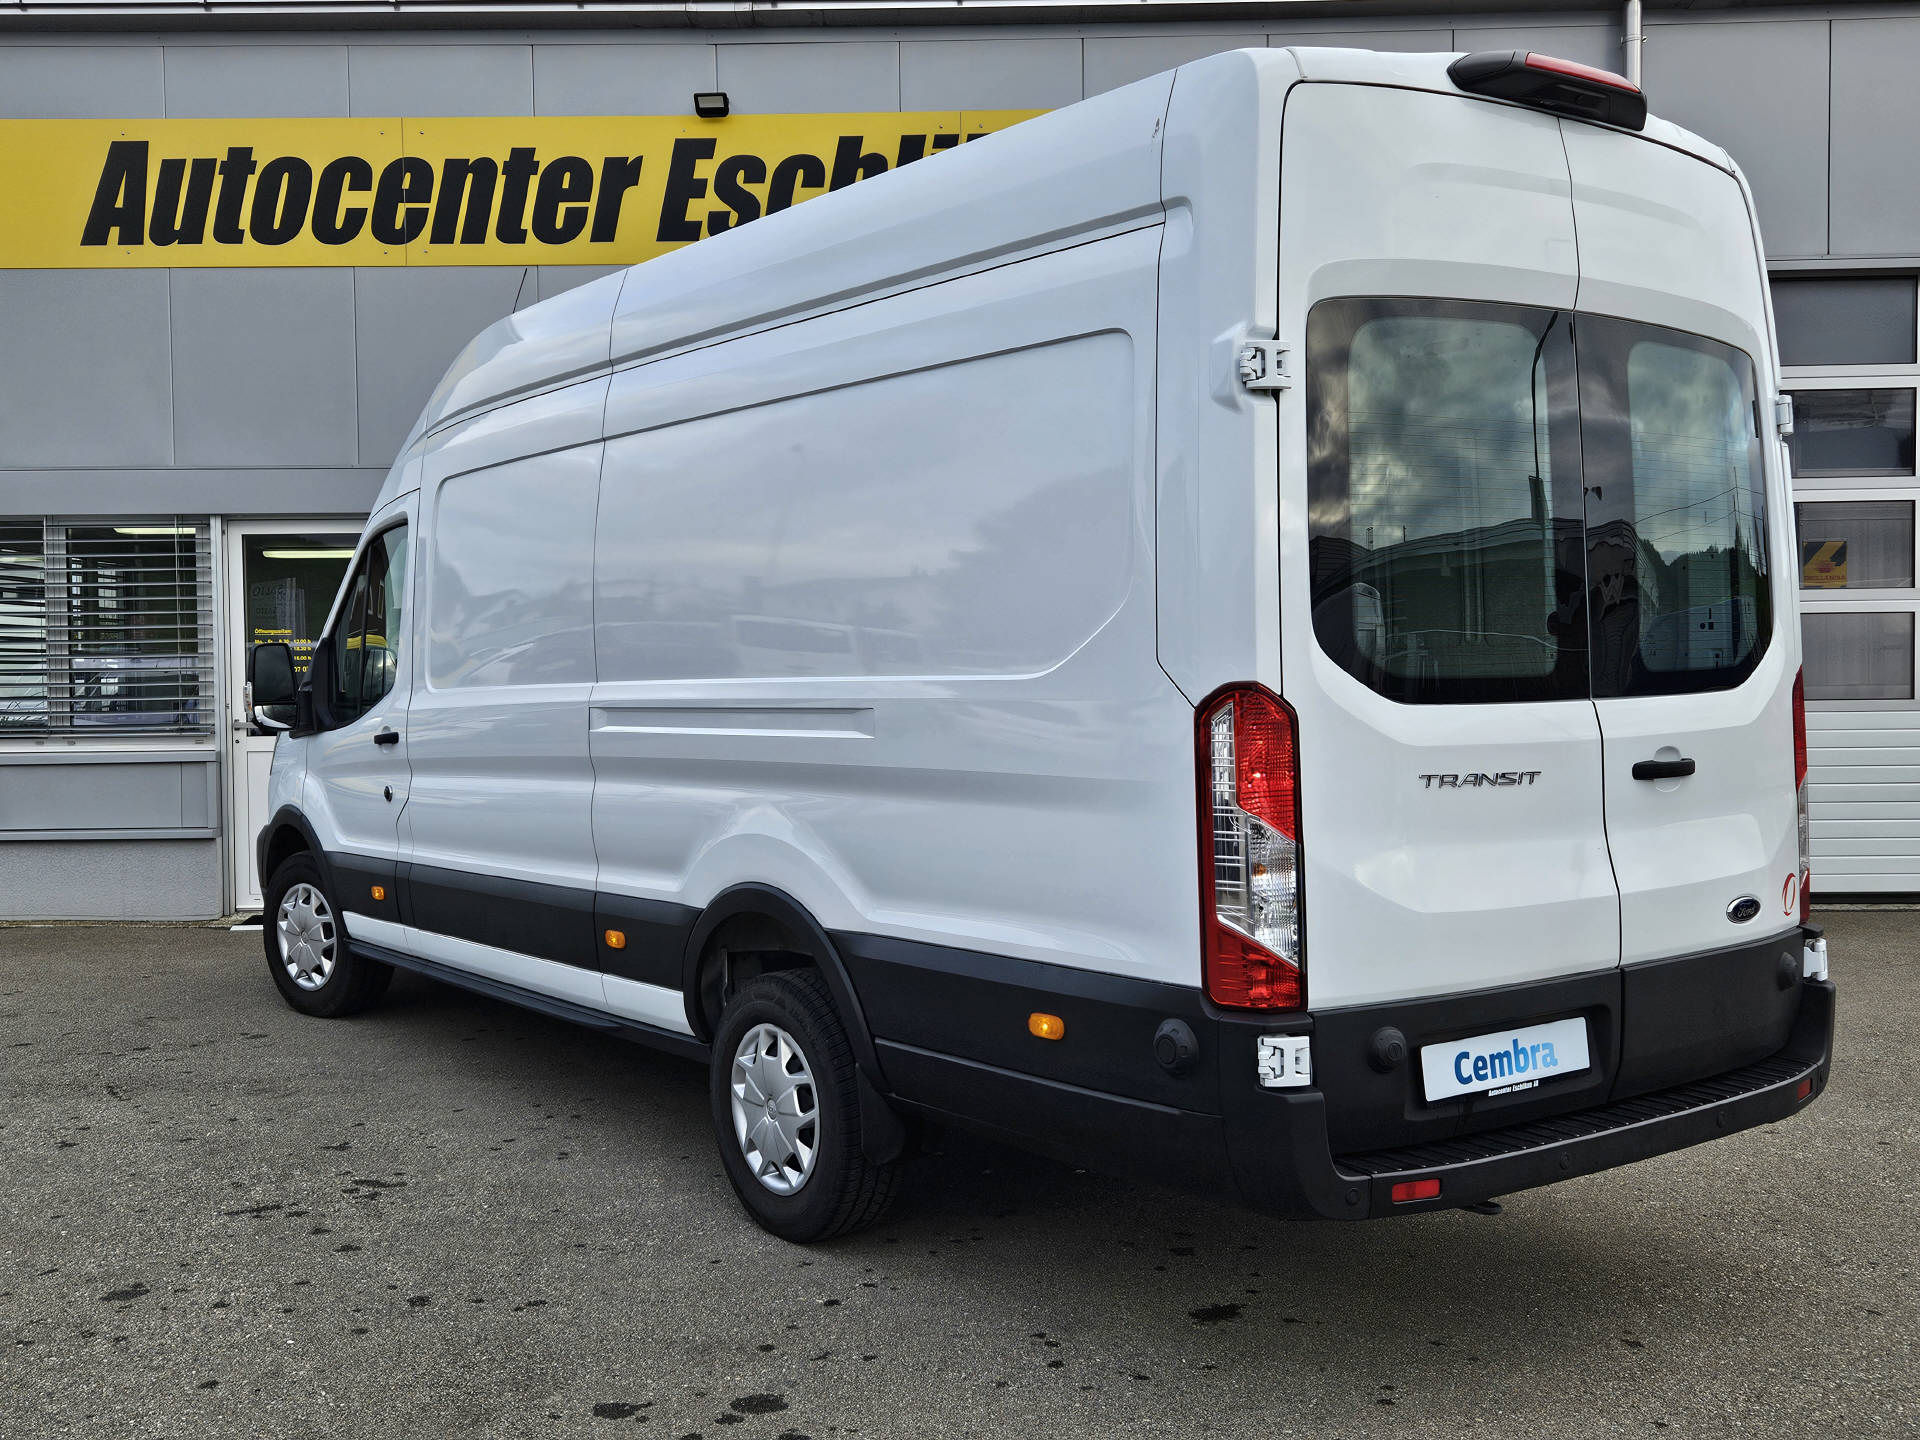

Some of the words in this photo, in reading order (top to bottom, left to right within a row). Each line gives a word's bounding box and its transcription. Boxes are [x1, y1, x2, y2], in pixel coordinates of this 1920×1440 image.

[81, 140, 642, 247] Autocenter
[1418, 771, 1542, 789] TRANSIT
[1454, 1038, 1558, 1085] Cembra
